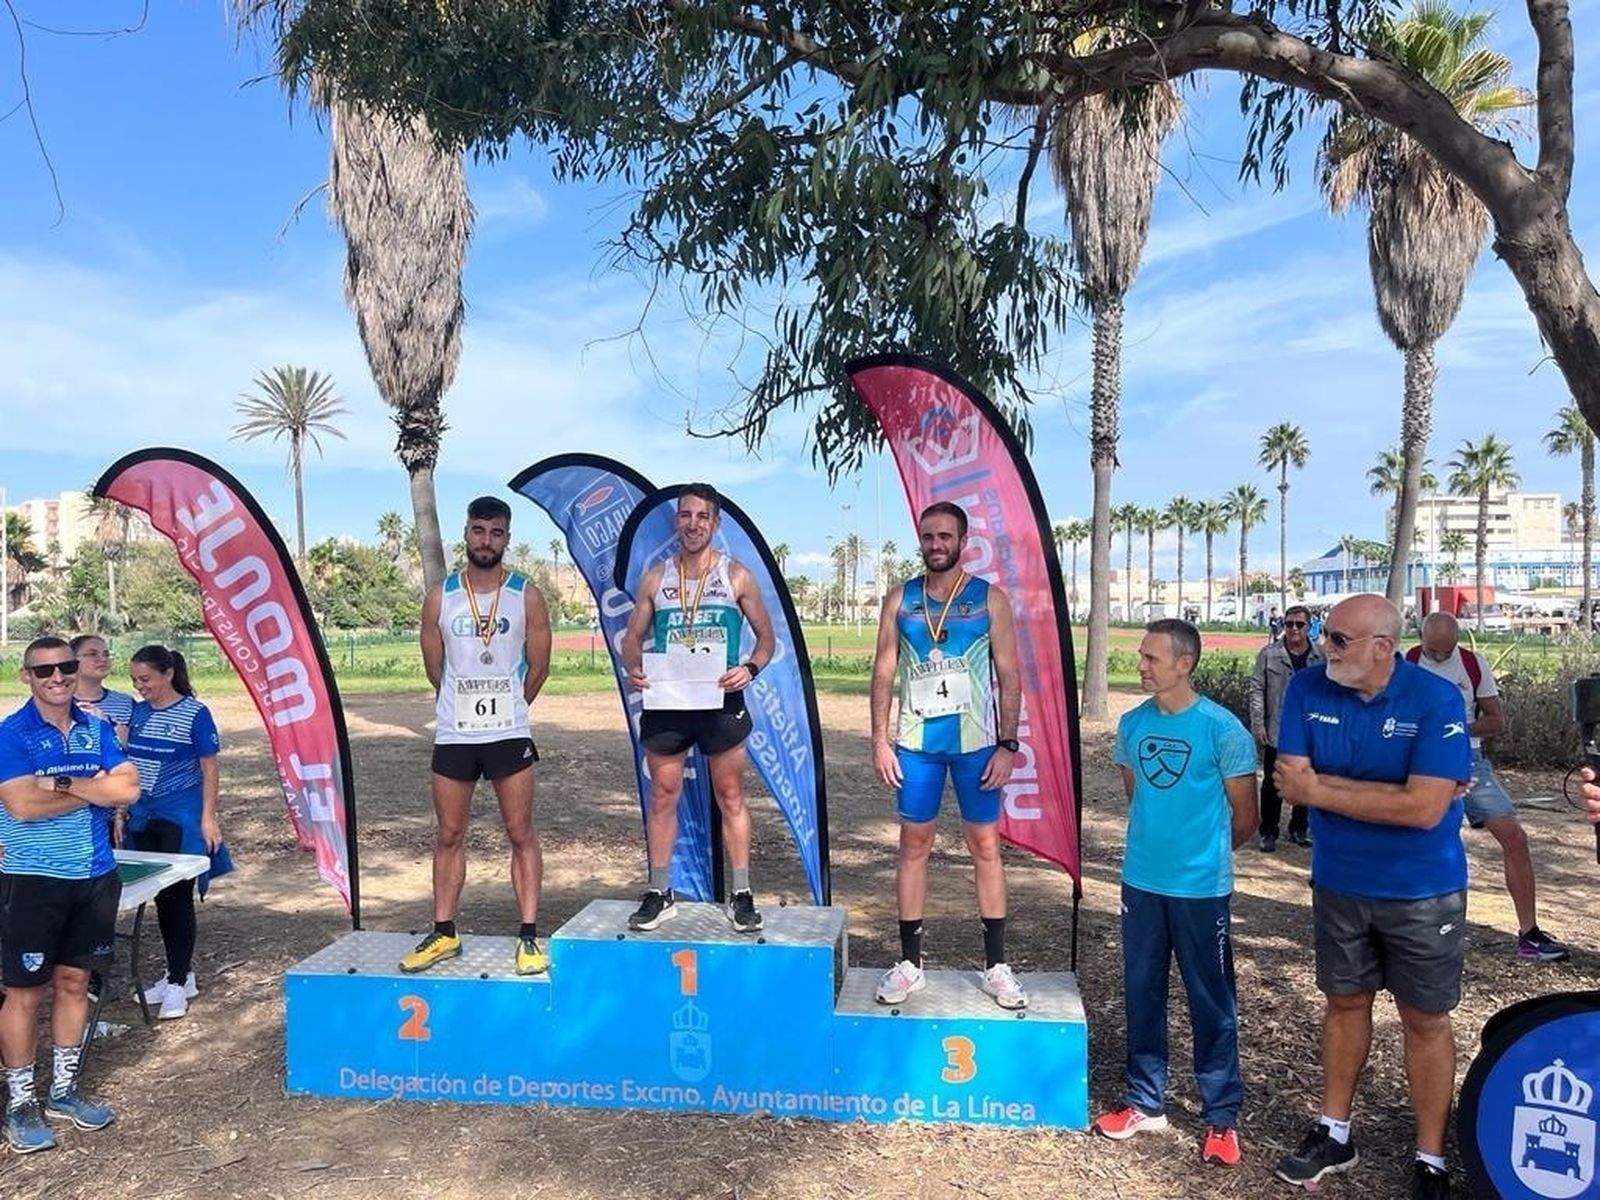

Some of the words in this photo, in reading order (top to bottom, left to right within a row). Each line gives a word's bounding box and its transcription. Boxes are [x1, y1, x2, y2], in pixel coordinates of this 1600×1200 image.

[475, 696, 497, 717] 61
[936, 679, 949, 698] 4
[671, 948, 698, 996] 1
[397, 995, 431, 1041] 2
[940, 1035, 977, 1084] 3
[339, 1066, 467, 1099] Delegación
[472, 1073, 503, 1096] de
[507, 1074, 616, 1102] Deportes
[620, 1078, 705, 1105] Excmo.
[711, 1083, 888, 1116] Ayuntamiento
[893, 1092, 926, 1117] de
[931, 1093, 961, 1118] La
[967, 1094, 1037, 1121] Línea
